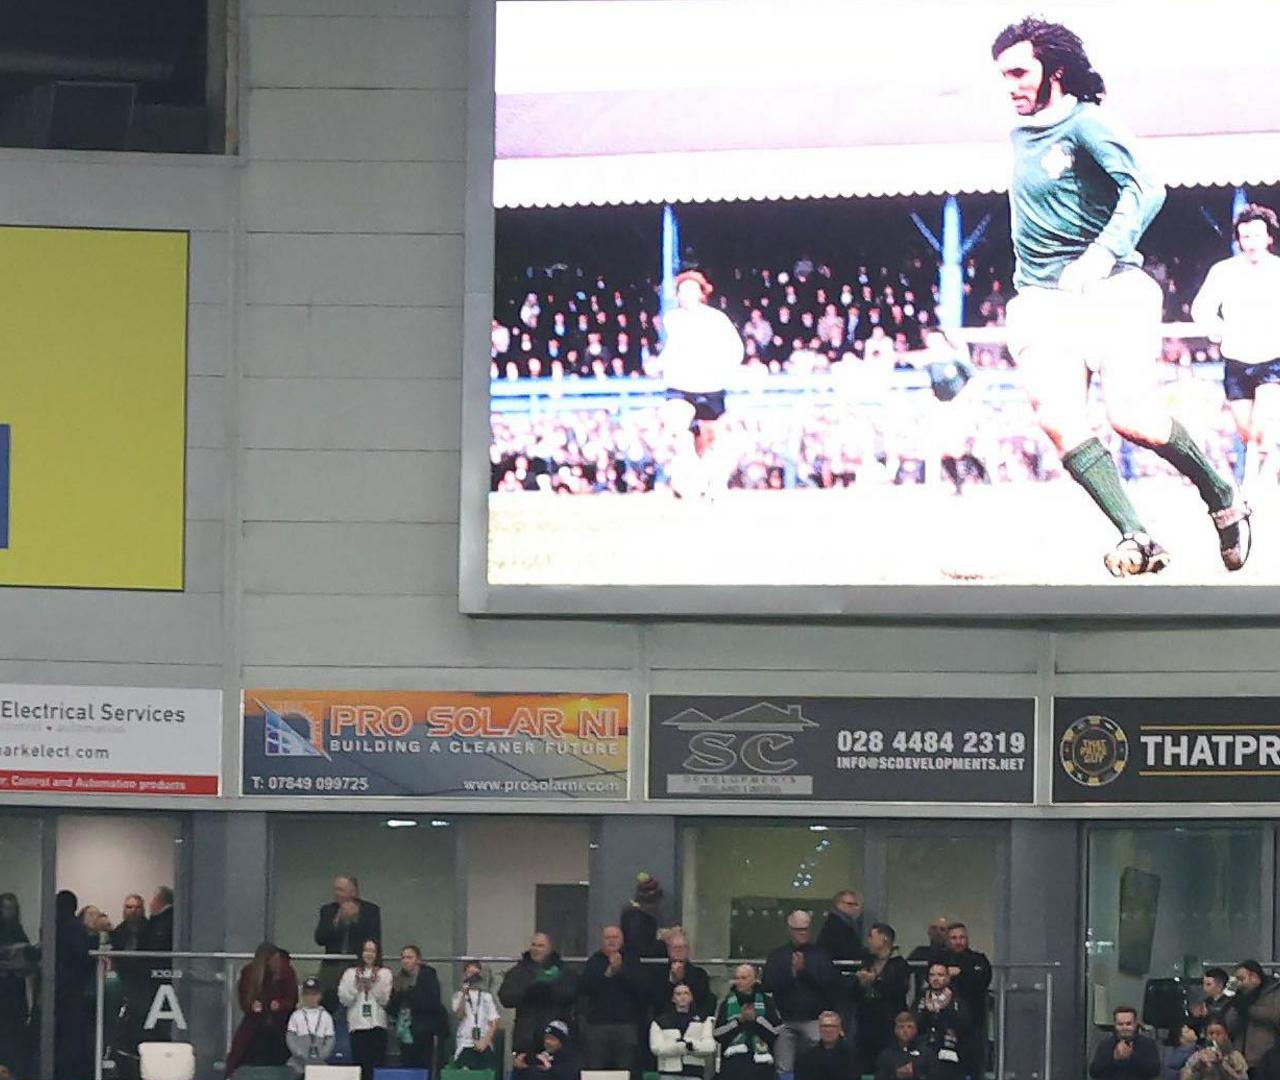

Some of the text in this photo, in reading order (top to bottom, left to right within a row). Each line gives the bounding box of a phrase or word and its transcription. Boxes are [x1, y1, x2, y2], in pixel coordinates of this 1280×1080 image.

[1, 700, 94, 720] Electrical
[100, 703, 185, 723] Services
[330, 704, 619, 741] PRO SOLAR NI
[330, 739, 618, 756] BUILDING A CLEANER FUTURE
[682, 732, 798, 774] SC
[837, 730, 1026, 754] 028 4484 2319
[836, 756, 1025, 771] INFO@SCDEVELOPMENTS.NET
[315, 777, 369, 791] 099725
[143, 984, 187, 1030] A
